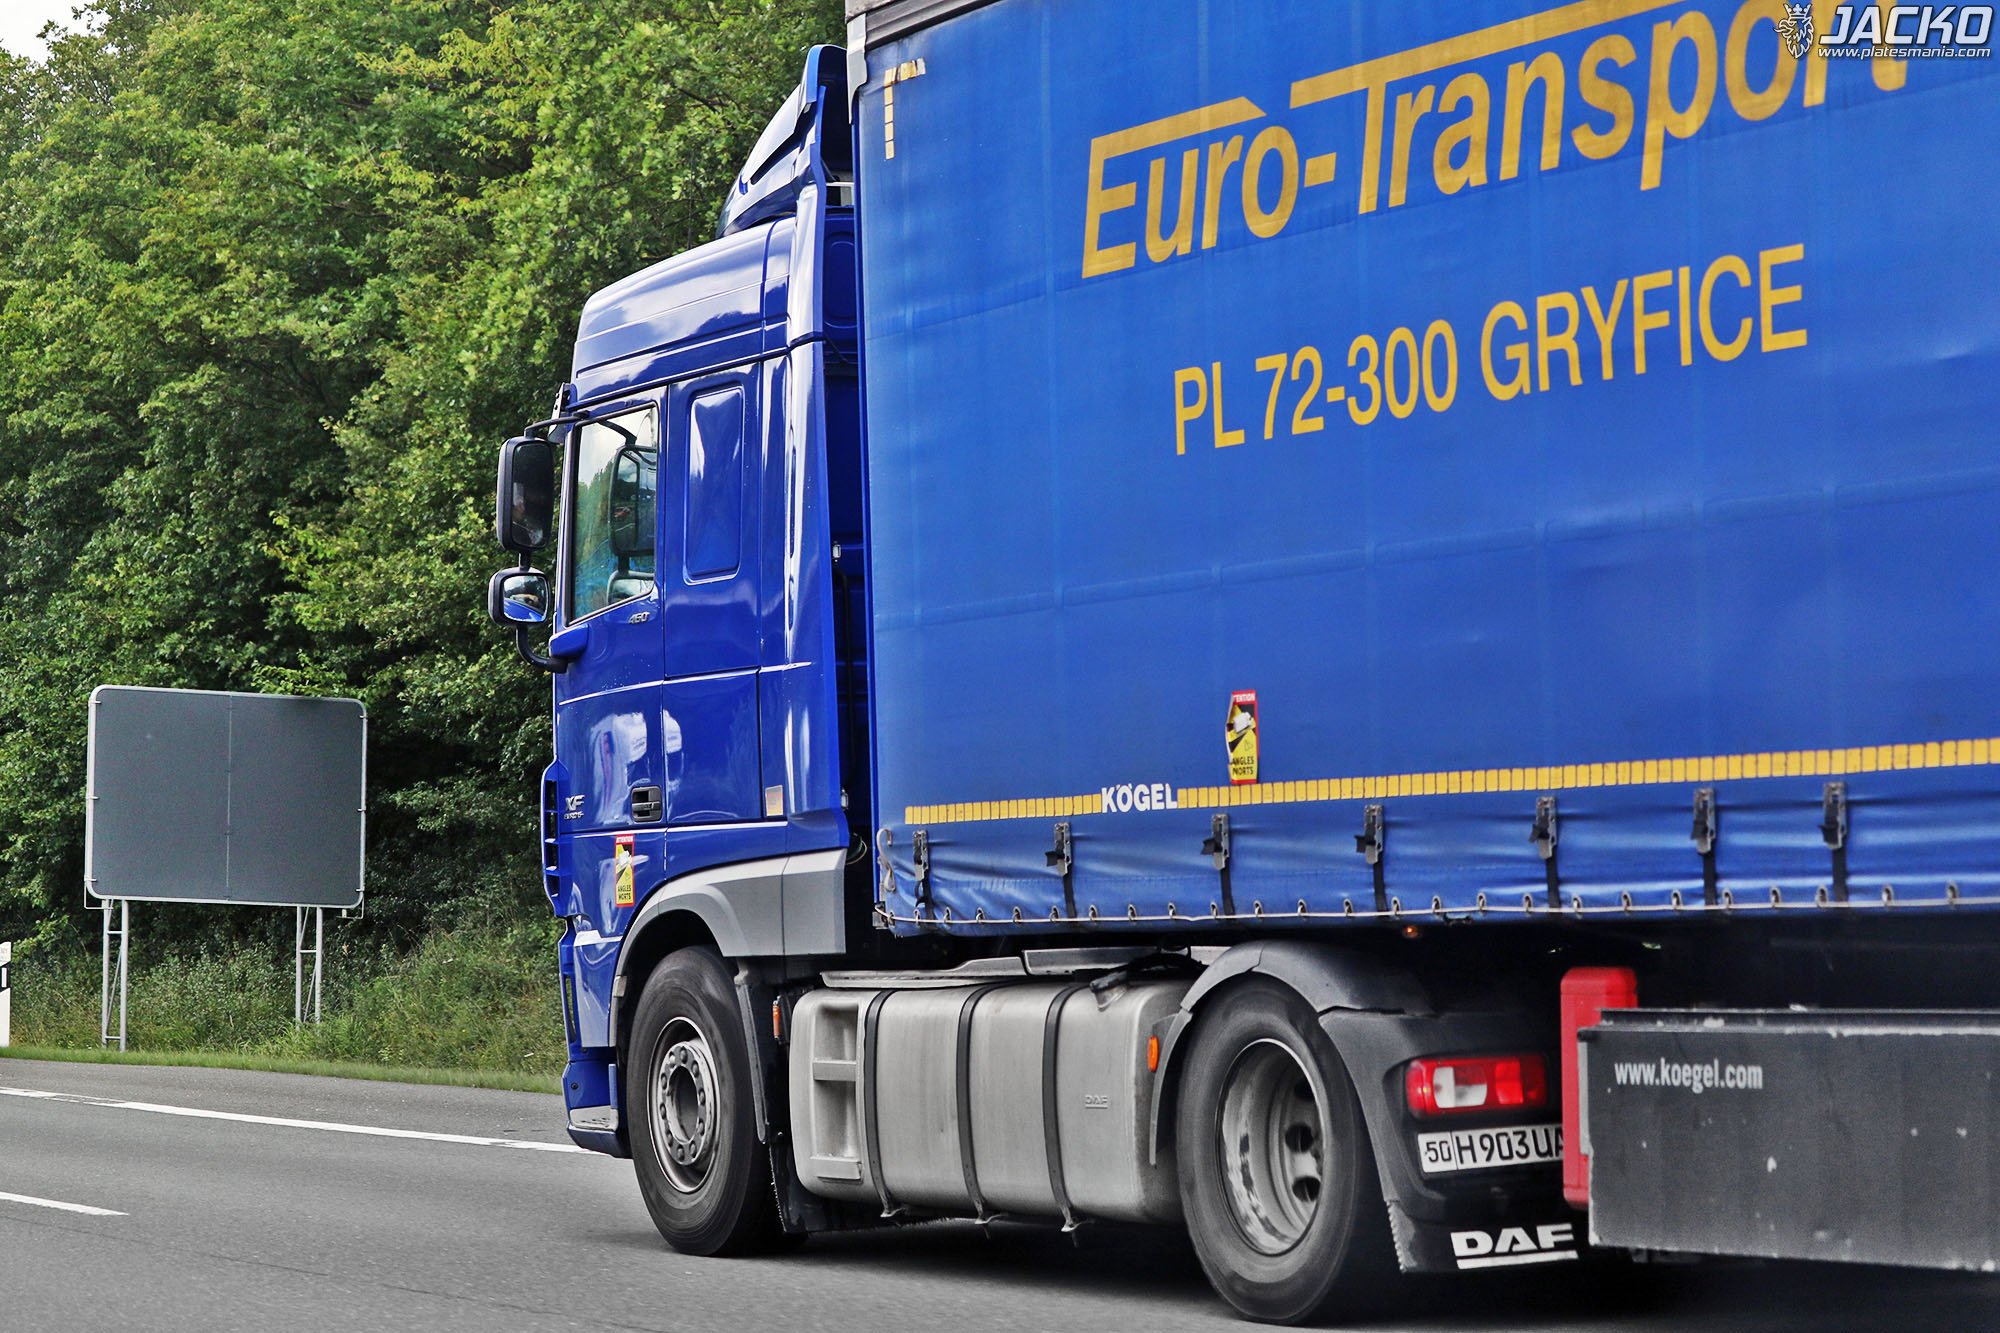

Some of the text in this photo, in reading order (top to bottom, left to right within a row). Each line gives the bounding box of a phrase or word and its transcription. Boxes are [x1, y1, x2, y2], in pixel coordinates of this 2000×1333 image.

[1081, 0, 1908, 278] Euro-Transport
[1175, 243, 1808, 455] PL 72-300 GRYFICE
[1231, 756, 1254, 765] ANGLES
[1232, 766, 1253, 776] MORTS
[565, 794, 585, 811] XF
[1101, 783, 1177, 813] KÖGEL
[1614, 1056, 1763, 1094] www.koegel.com
[1426, 1140, 1451, 1163] 50
[1450, 1222, 1574, 1257] DAF
